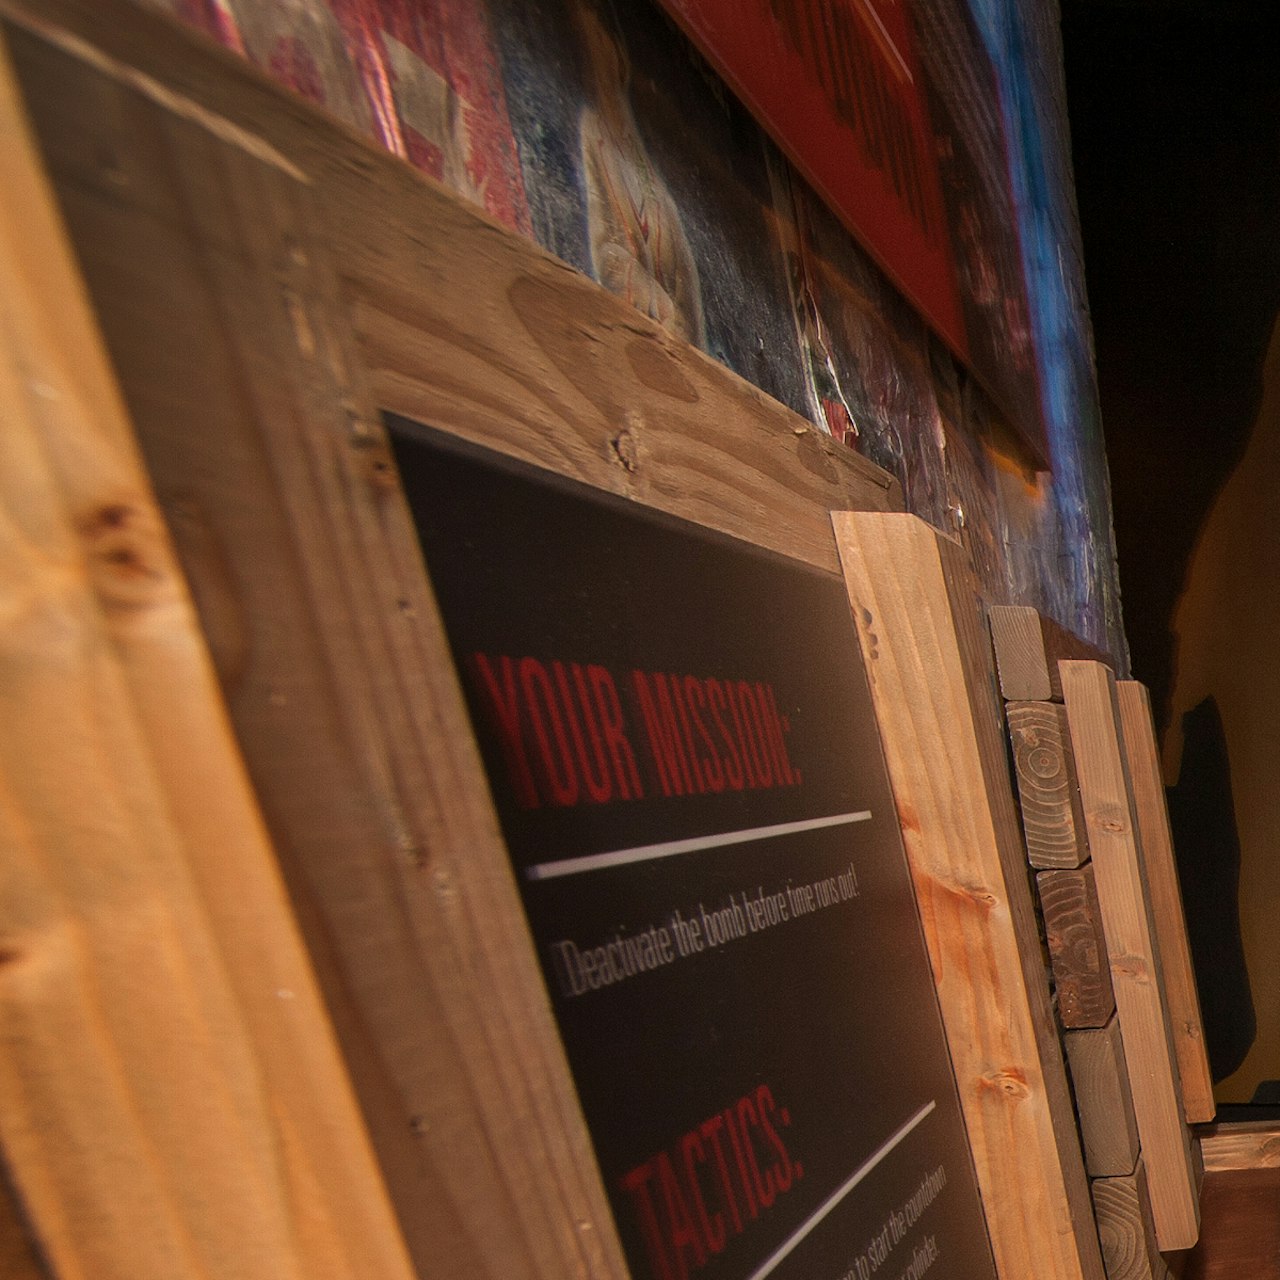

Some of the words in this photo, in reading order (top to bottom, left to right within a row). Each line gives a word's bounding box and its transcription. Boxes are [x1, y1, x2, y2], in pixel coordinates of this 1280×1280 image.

[473, 650, 644, 808] YOUR
[631, 668, 802, 798] MISSION:
[558, 924, 675, 996] Deactivate
[671, 909, 705, 957] the
[700, 894, 748, 947] bomb
[742, 885, 791, 933] before
[786, 877, 815, 919] time
[815, 878, 839, 907] runs
[867, 1226, 893, 1273] start
[888, 1209, 908, 1245] the
[904, 1163, 947, 1228] countdown
